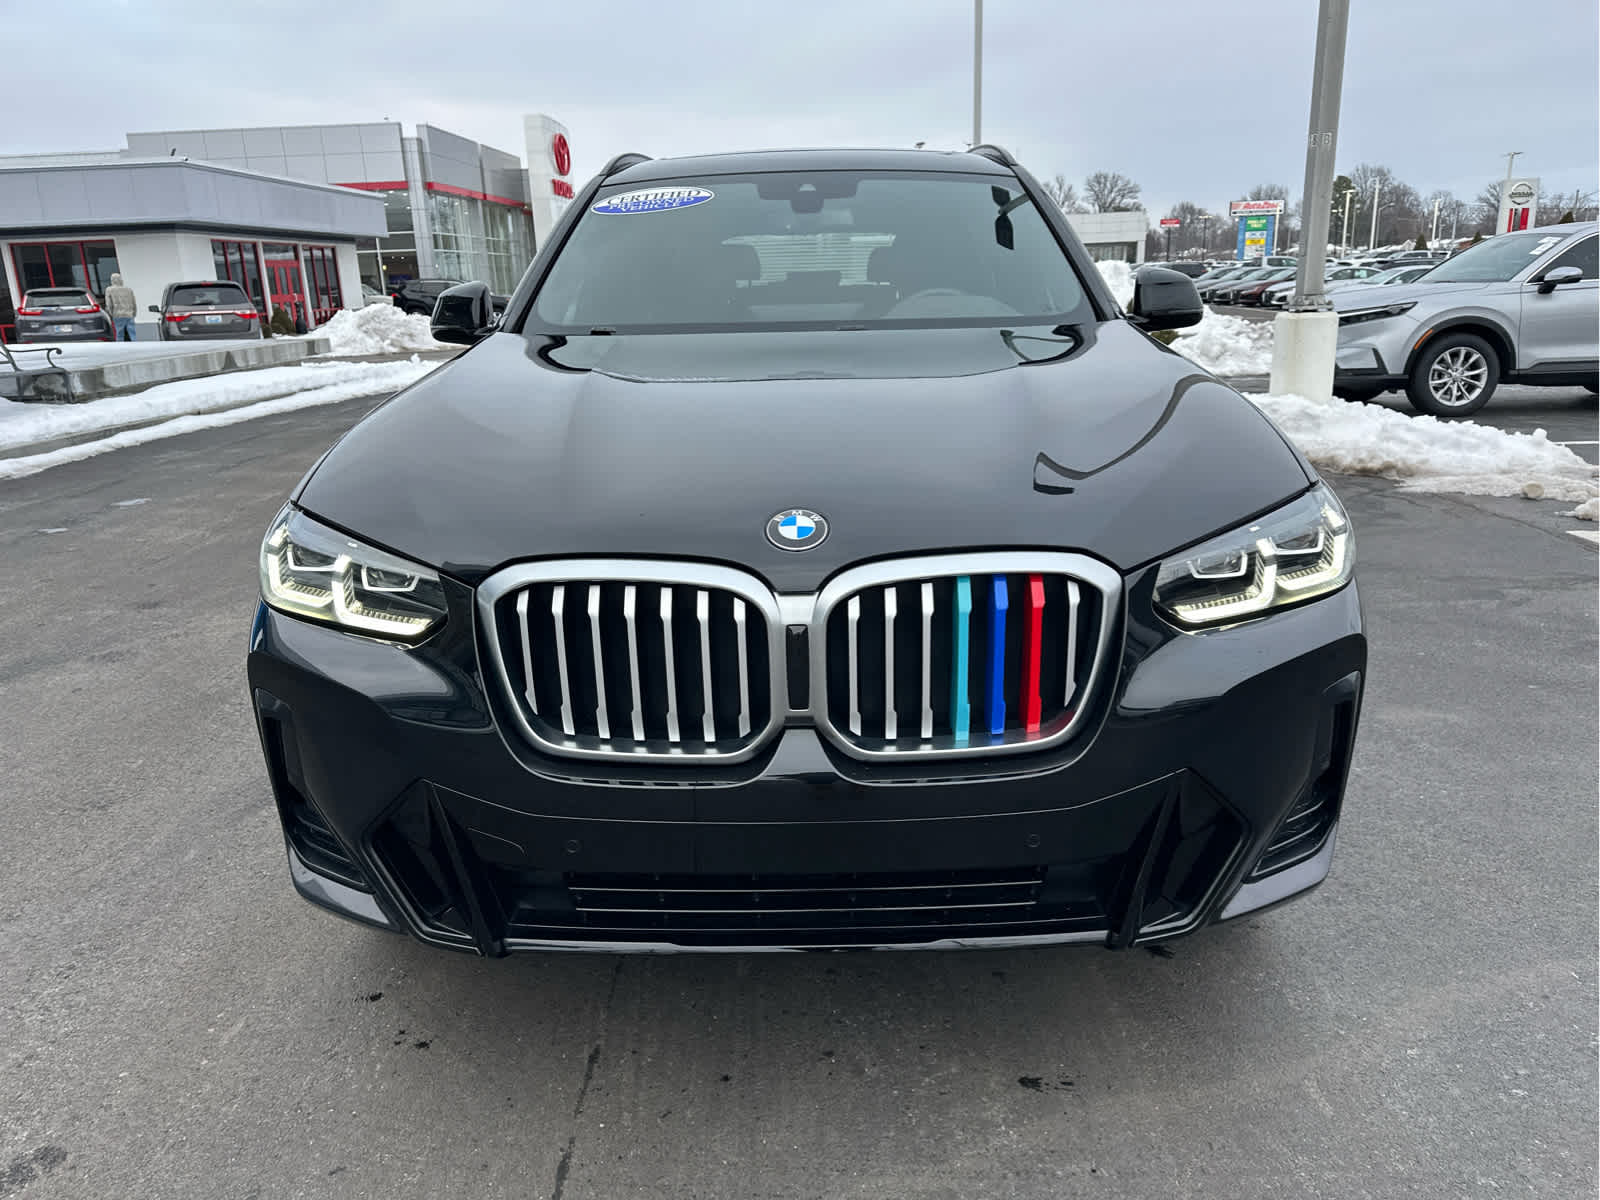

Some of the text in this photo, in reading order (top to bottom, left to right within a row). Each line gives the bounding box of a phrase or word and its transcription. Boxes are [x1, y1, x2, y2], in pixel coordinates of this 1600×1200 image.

[607, 189, 702, 206] CERTIFIED
[620, 201, 681, 212] VEHICLE
[1242, 200, 1281, 209] AutoZon
[773, 509, 824, 522] BMW
